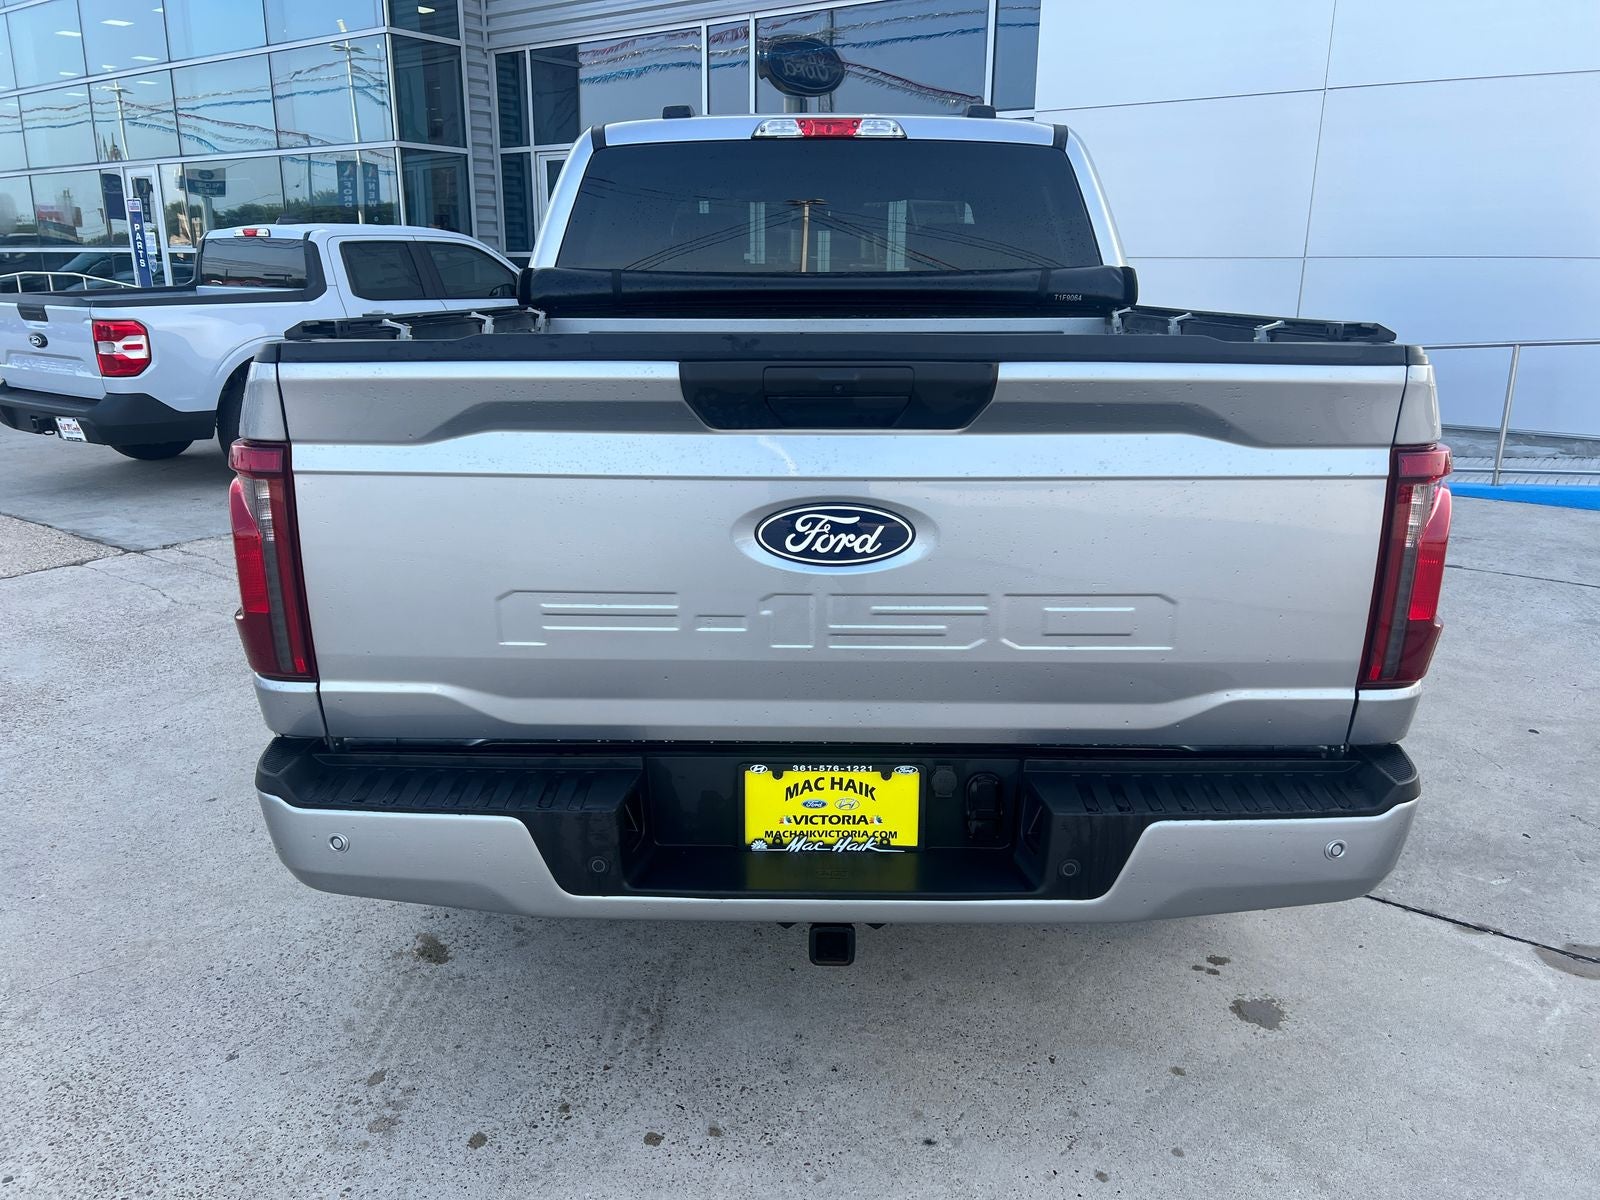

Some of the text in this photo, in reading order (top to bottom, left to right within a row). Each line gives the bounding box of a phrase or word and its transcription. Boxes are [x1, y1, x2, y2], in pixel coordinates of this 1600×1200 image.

[133, 223, 146, 268] PARTS
[784, 514, 883, 555] Ford
[494, 589, 1179, 651] F-150
[792, 764, 874, 773] 361-576-1221
[785, 776, 876, 802] MAC HAIK
[805, 800, 825, 808] Ford
[792, 814, 869, 825] VICTORIA
[764, 829, 898, 840] MACHAIKVICTORIA.COM
[785, 836, 881, 853] Mac Haik
